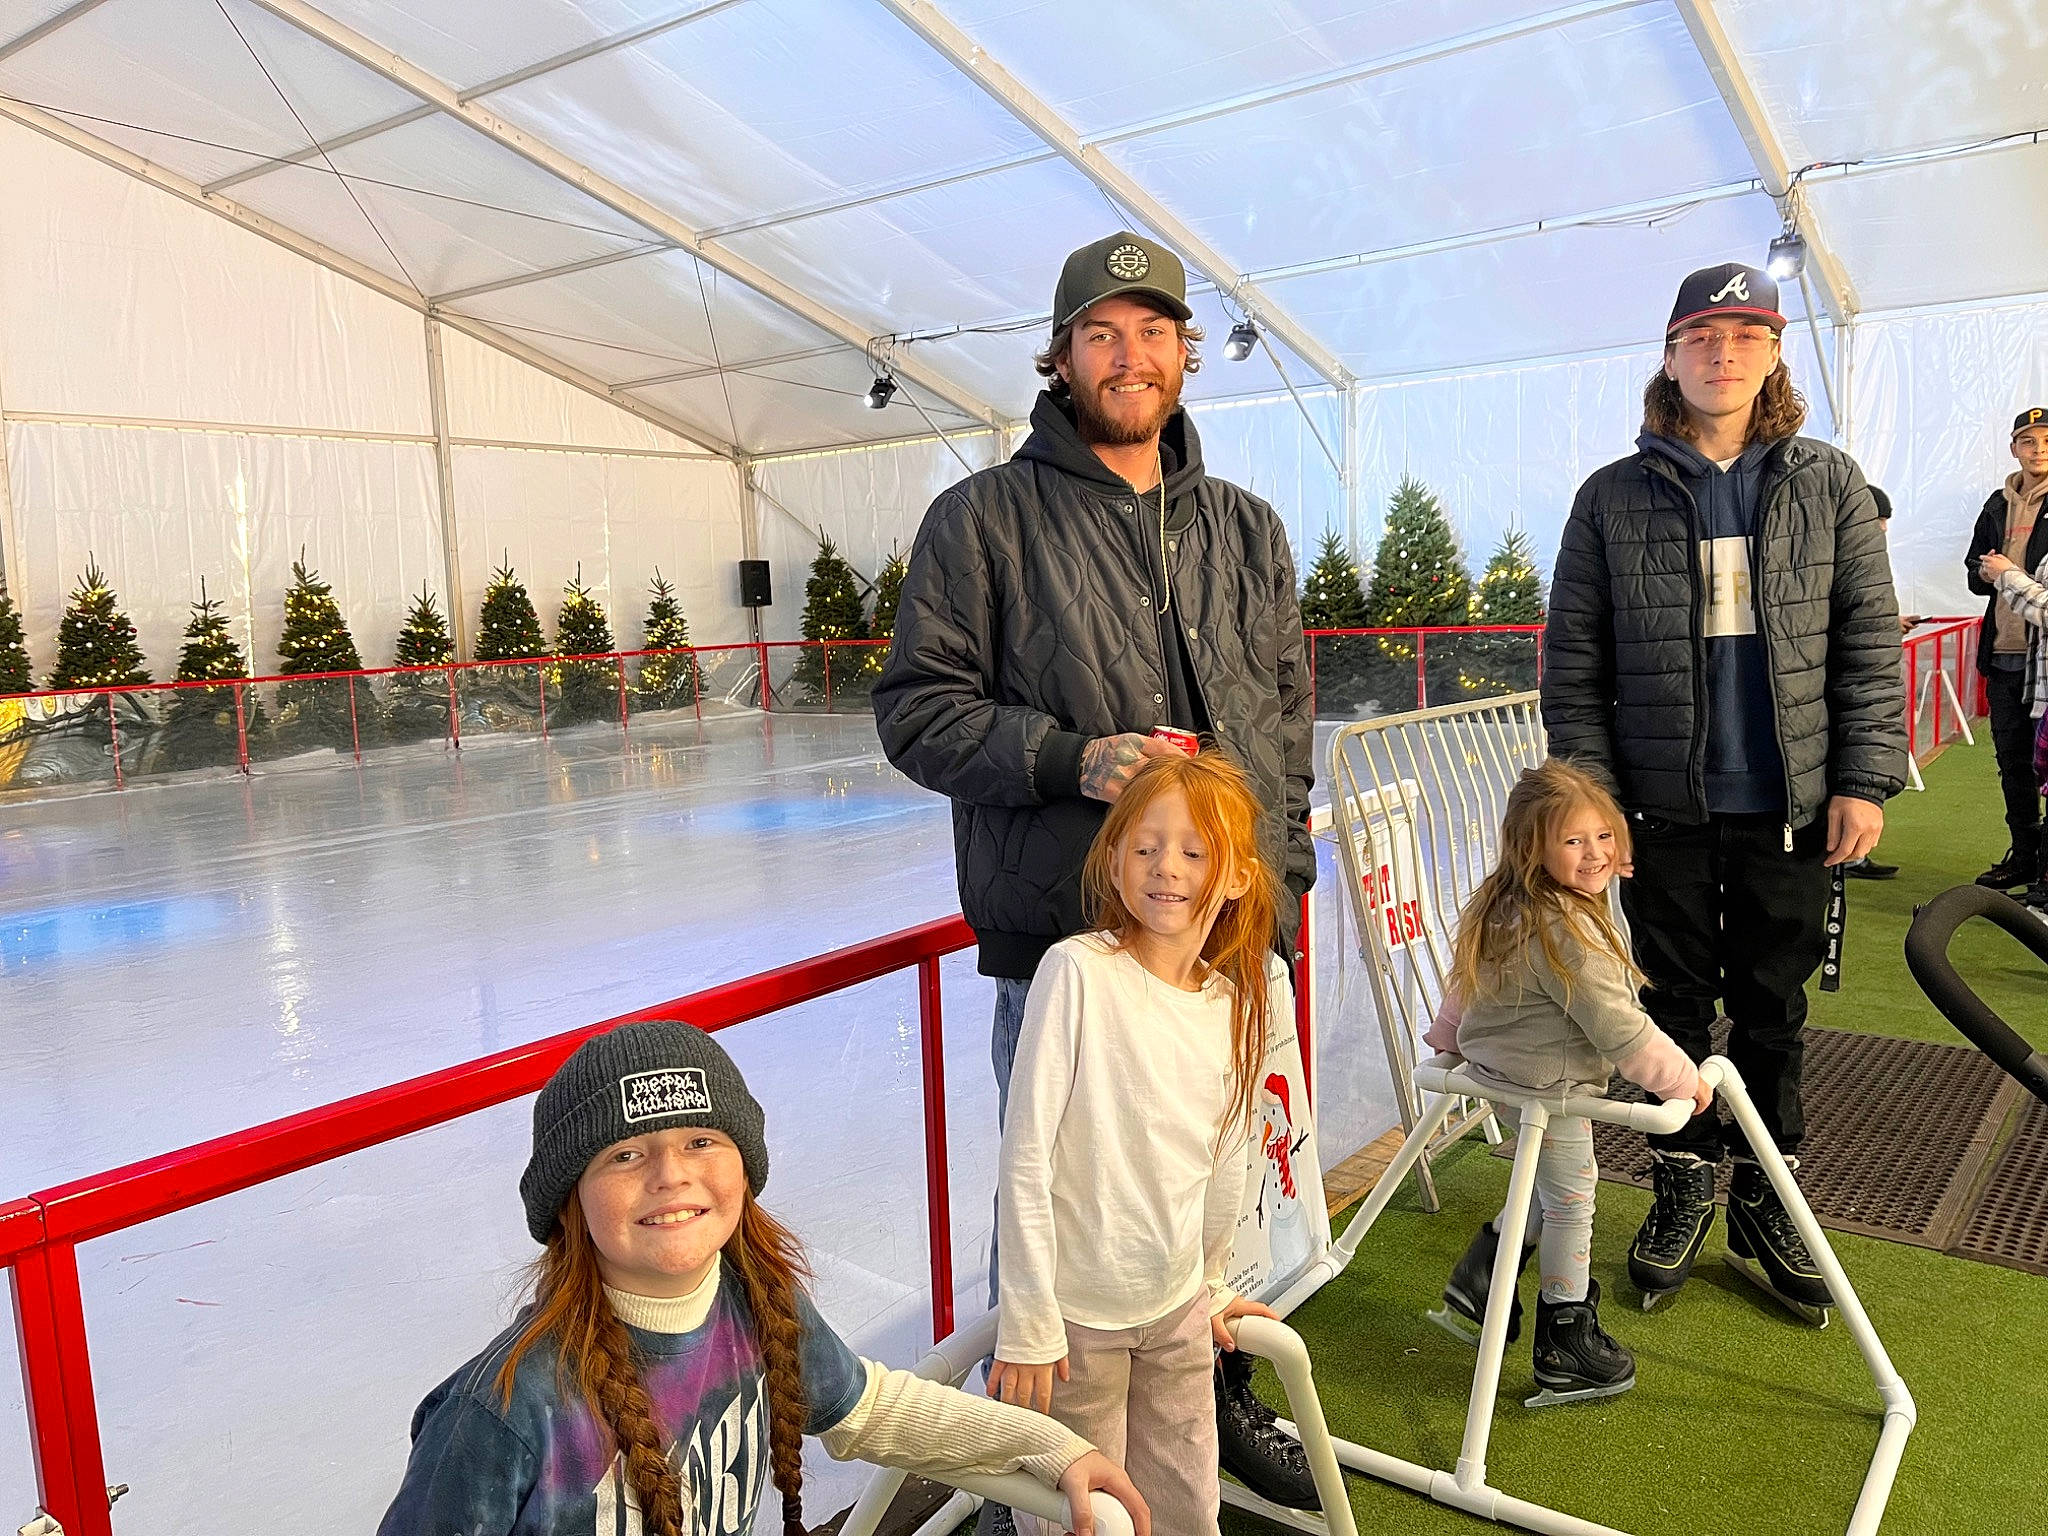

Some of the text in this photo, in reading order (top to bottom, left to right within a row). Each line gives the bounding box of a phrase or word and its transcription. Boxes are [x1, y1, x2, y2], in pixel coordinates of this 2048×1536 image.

[1109, 244, 1148, 261] BRIXTON
[1709, 271, 1751, 303] A
[2029, 409, 2043, 424] P
